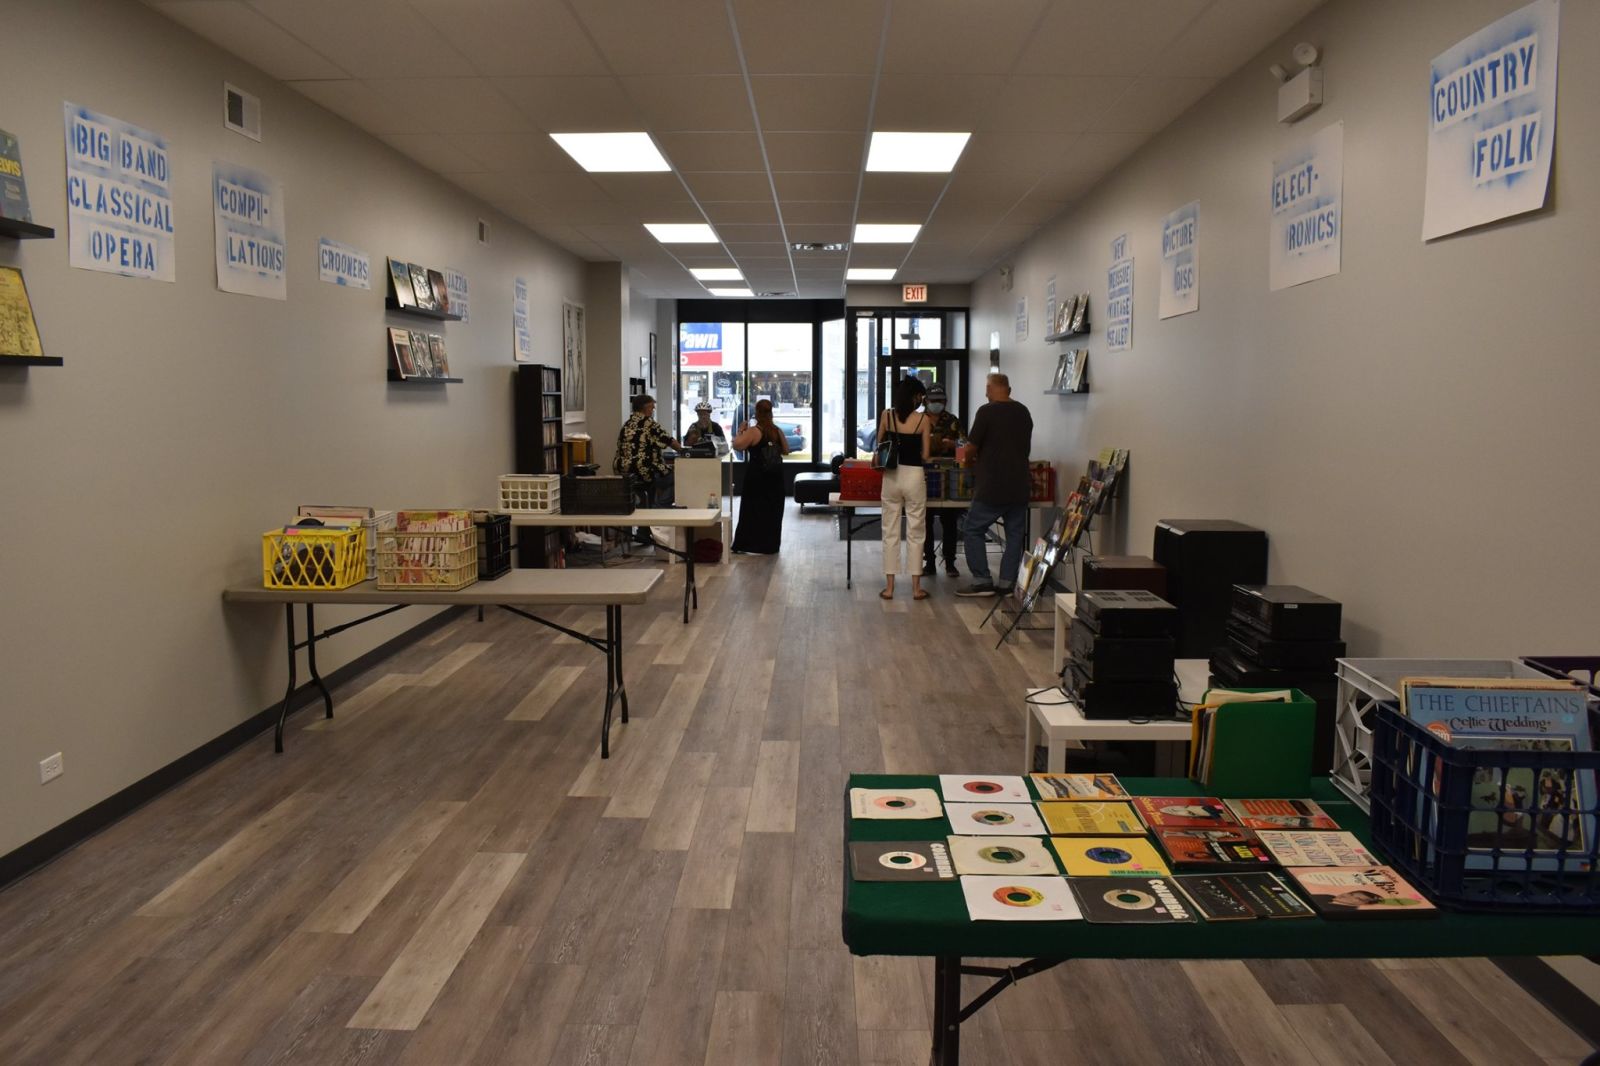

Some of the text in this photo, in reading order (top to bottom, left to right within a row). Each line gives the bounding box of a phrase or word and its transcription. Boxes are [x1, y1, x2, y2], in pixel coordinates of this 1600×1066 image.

[1434, 43, 1535, 123] COUNTRY
[0, 156, 21, 177] ELVIS
[76, 123, 167, 182] BIG BAND
[1475, 121, 1537, 178] FOLK
[68, 176, 173, 233] CLASSICAL
[1165, 223, 1193, 252] PICTURE
[1288, 211, 1334, 250] RONICS
[92, 231, 155, 271] OPERA
[229, 236, 282, 271] LATIONS
[322, 249, 368, 280] CROONERS
[905, 287, 924, 300] EXIT
[1175, 269, 1193, 291] DISC
[1415, 693, 1581, 714] THE CHIEFTAINS
[1450, 716, 1547, 732] Celtic Wedding
[1148, 879, 1189, 920] COLUMBIA
